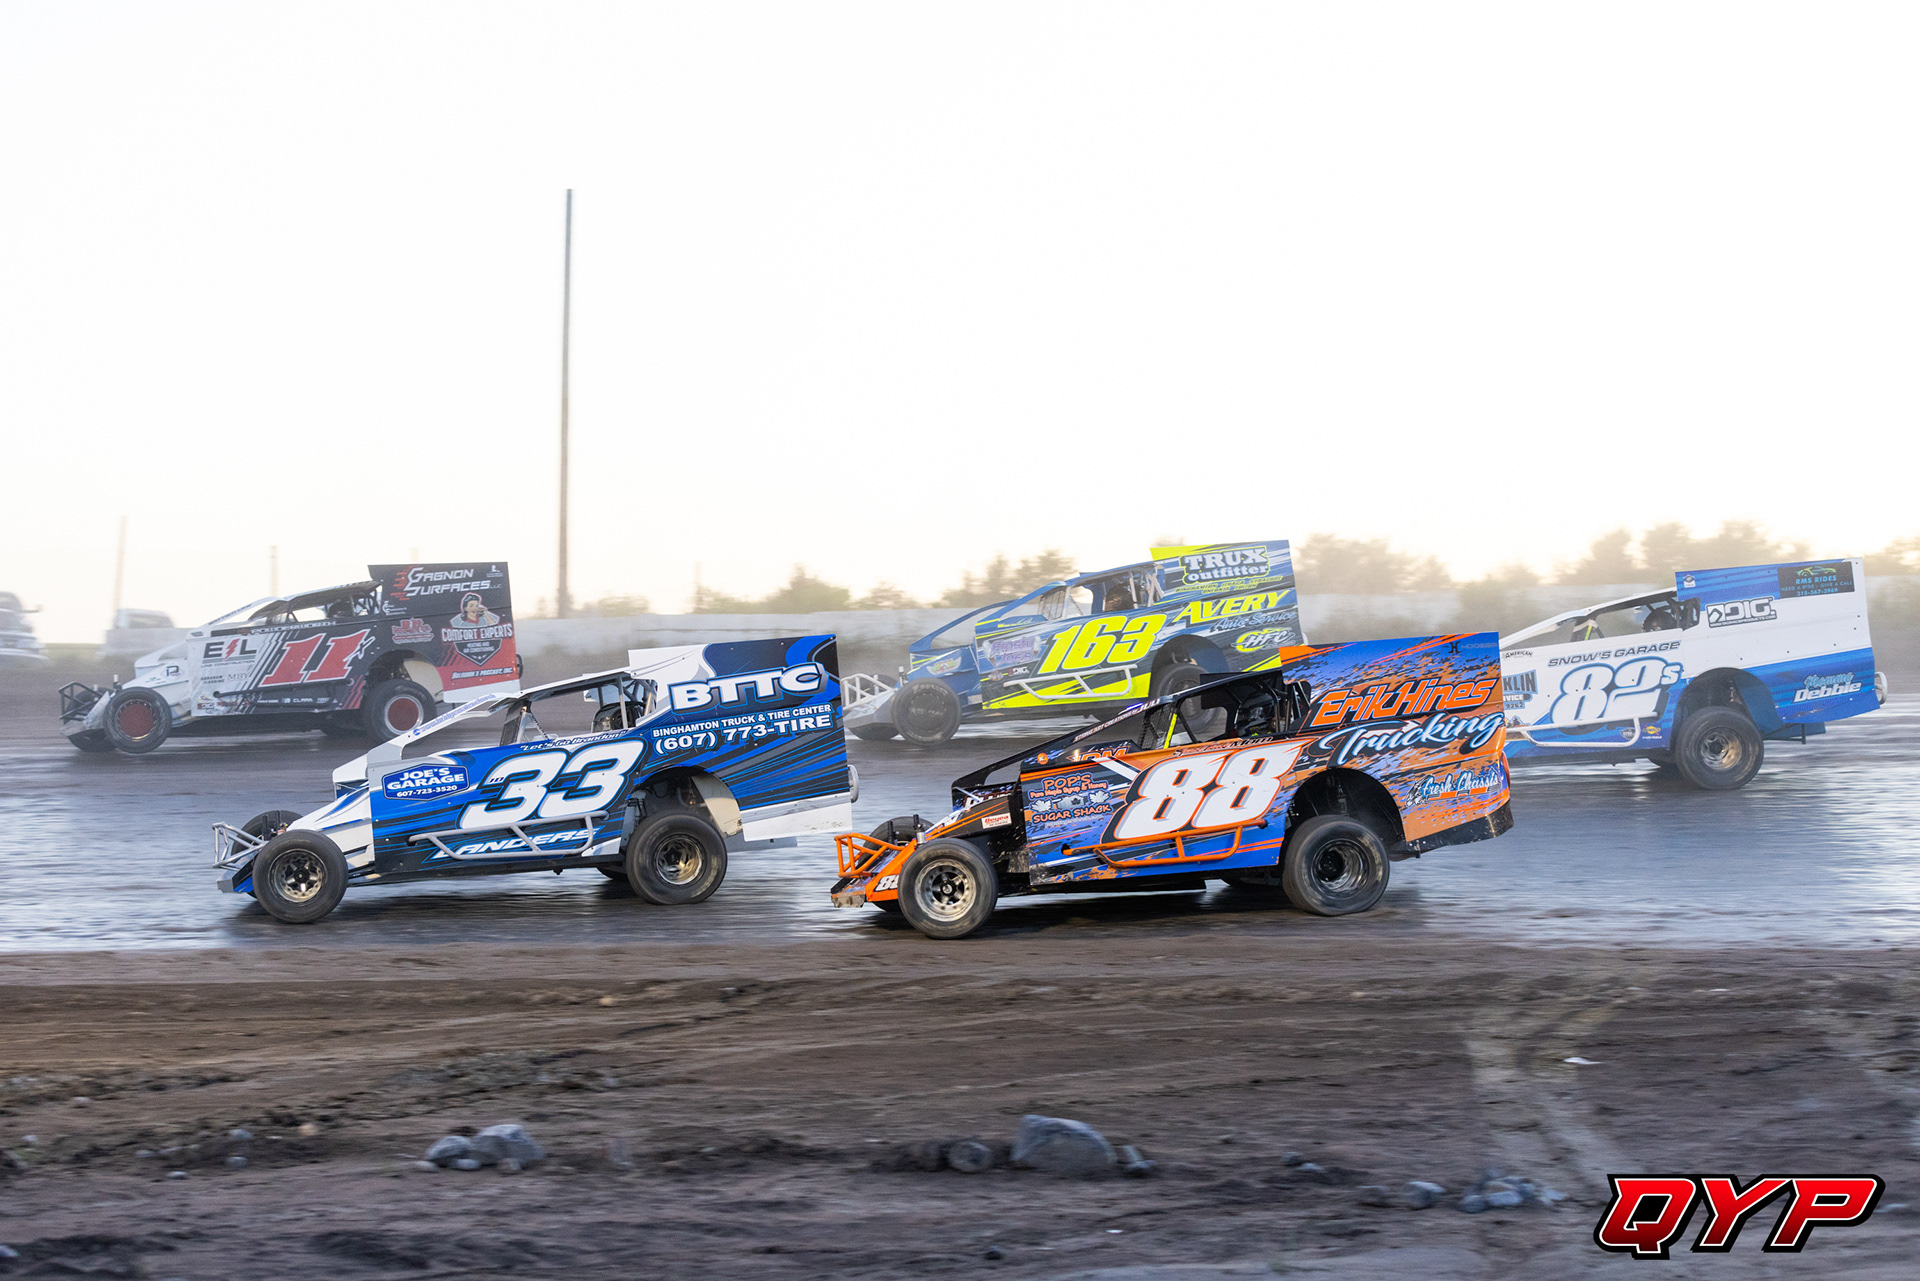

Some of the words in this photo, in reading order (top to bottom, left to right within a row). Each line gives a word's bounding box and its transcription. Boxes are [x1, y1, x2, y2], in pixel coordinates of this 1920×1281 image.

[1184, 548, 1268, 571] TRUX
[407, 567, 475, 582] GAGNON
[1187, 565, 1269, 581] outfitter
[1795, 577, 1813, 585] RMS
[403, 580, 491, 597] SURFACES
[1172, 589, 1290, 624] AVERY
[1214, 616, 1247, 632] Auto
[1248, 611, 1297, 625] Service
[441, 629, 478, 642] COMFORT
[480, 623, 513, 639] EXPERTS
[1037, 614, 1168, 675] 163
[1461, 642, 1498, 650] HOOSIER
[1548, 650, 1611, 668] SNOW'S
[1614, 641, 1681, 658] GARAGE
[669, 662, 823, 711] BTTC
[1502, 671, 1537, 693] KLIN
[1793, 681, 1862, 703] Debbie
[652, 721, 719, 738] BINGHAMTON
[721, 714, 757, 728] TRUCK
[758, 713, 766, 723] &
[768, 709, 791, 721] TIRE
[792, 704, 832, 718] CENTER
[655, 731, 717, 755] (607)
[722, 714, 832, 742] 773-TIRE
[1319, 712, 1505, 766] Trucking
[387, 774, 465, 790] GARAGE
[400, 767, 451, 781] JOE'S
[459, 739, 646, 830] 33
[1043, 774, 1091, 790] POP'S
[1422, 772, 1453, 796] Fresh
[396, 785, 458, 798] 607-723-3520
[1030, 791, 1044, 799] Pure
[1045, 788, 1062, 797] Maple
[1063, 786, 1081, 795] Syrup
[1088, 782, 1107, 790] Honey
[1113, 738, 1303, 840] 88
[1033, 810, 1071, 823] SUGAR
[1073, 804, 1112, 818] SHACK
